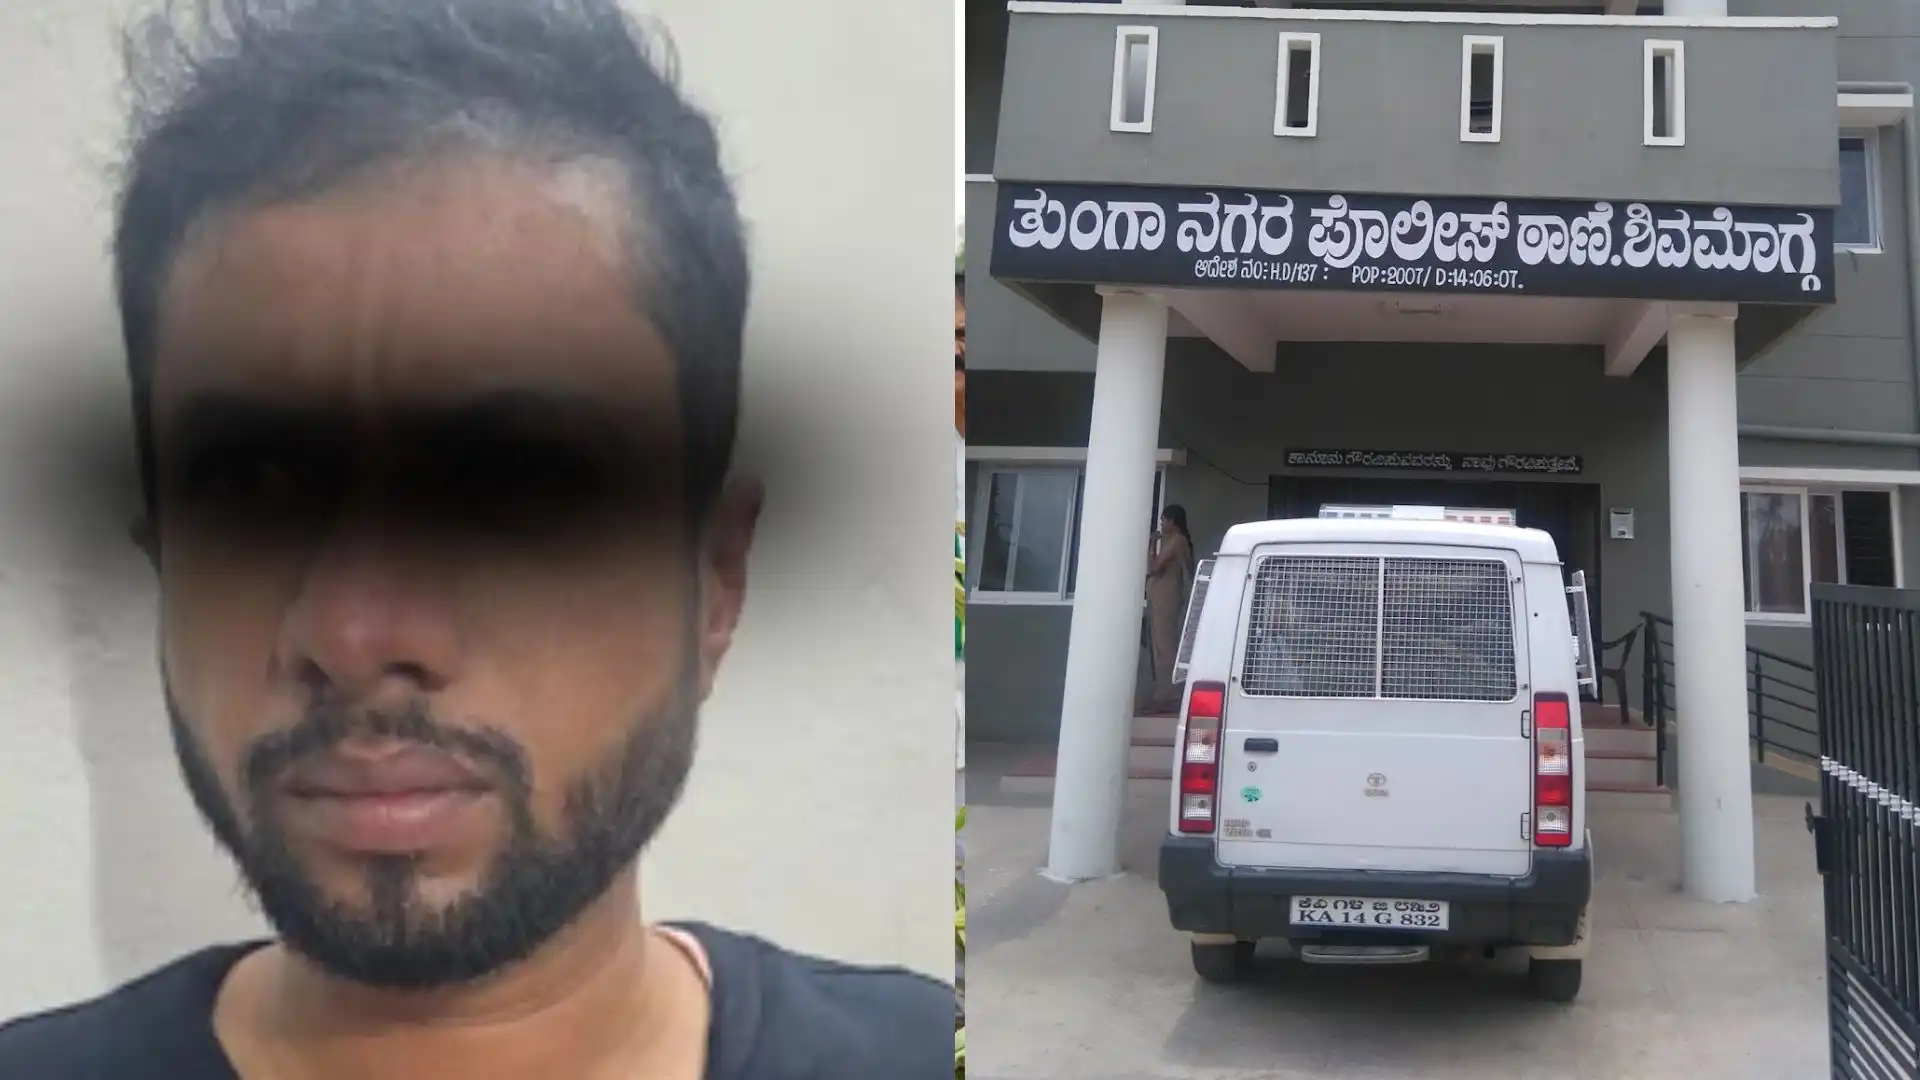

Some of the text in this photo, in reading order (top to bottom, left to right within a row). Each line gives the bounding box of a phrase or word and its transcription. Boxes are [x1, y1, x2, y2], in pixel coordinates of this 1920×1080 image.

[1008, 188, 1166, 251] ತುಂಗಾ
[1177, 192, 1294, 255] ನಗರ
[1308, 194, 1510, 268] ಪೊಲೀಸ್
[1298, 909, 1440, 926] KA 14 G 832
